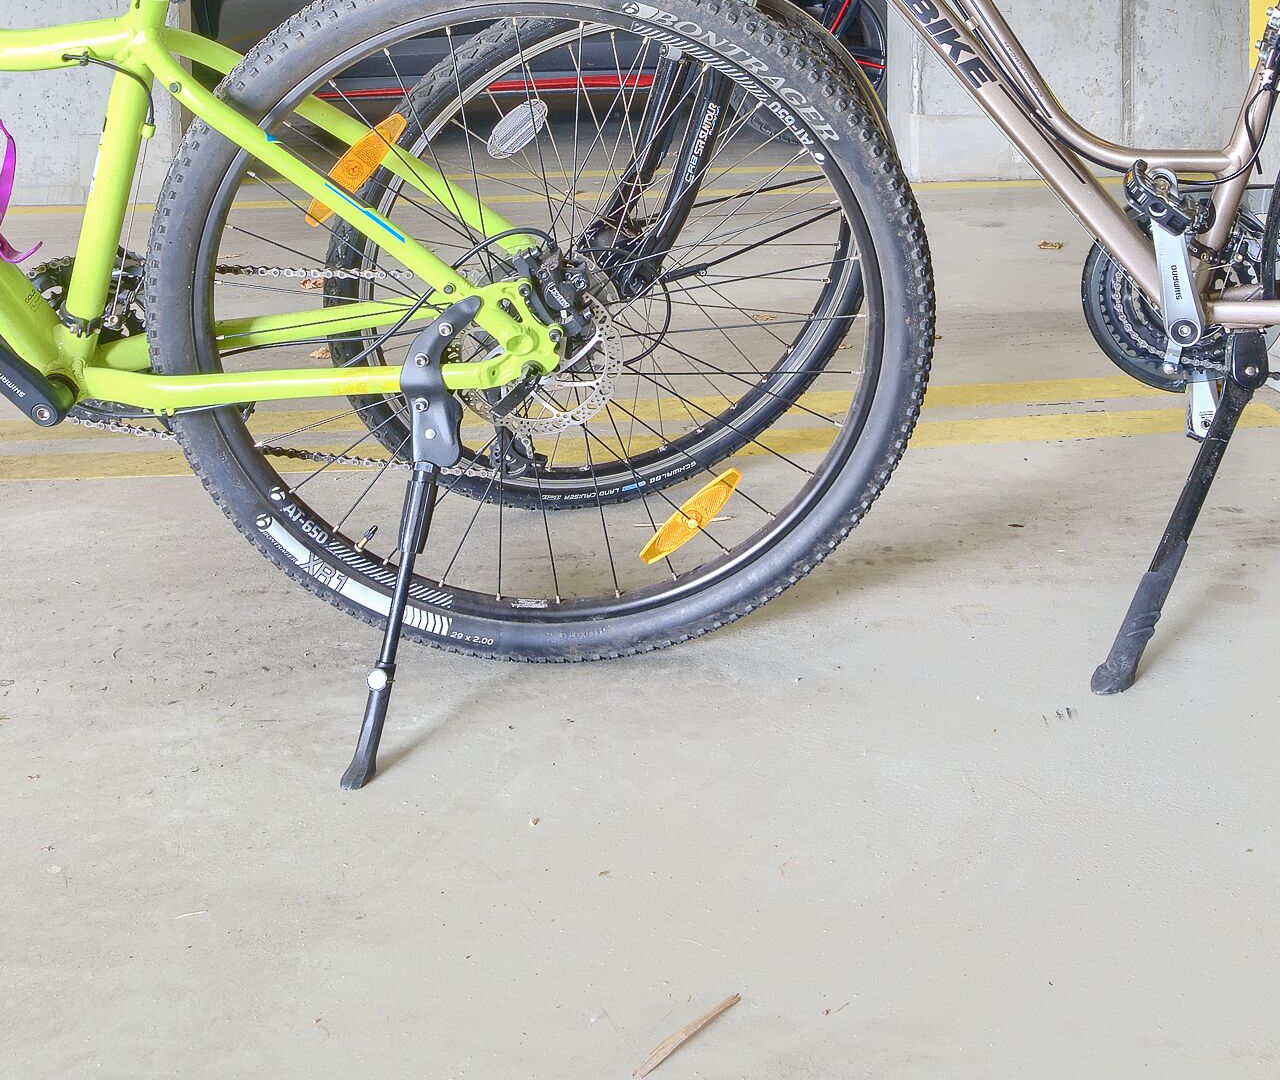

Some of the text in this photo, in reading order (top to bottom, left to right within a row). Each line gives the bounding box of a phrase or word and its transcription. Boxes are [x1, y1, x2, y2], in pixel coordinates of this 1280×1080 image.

[650, 9, 841, 142] BONTRAGER
[698, 102, 718, 142] SUNTOUR
[1170, 264, 1183, 301] SHIMANO
[563, 492, 597, 501] CRUISER
[598, 487, 620, 497] LAND
[282, 503, 329, 545] AT-650
[299, 550, 349, 594] XR1
[450, 631, 464, 640] 29
[472, 636, 495, 647] 2.00
